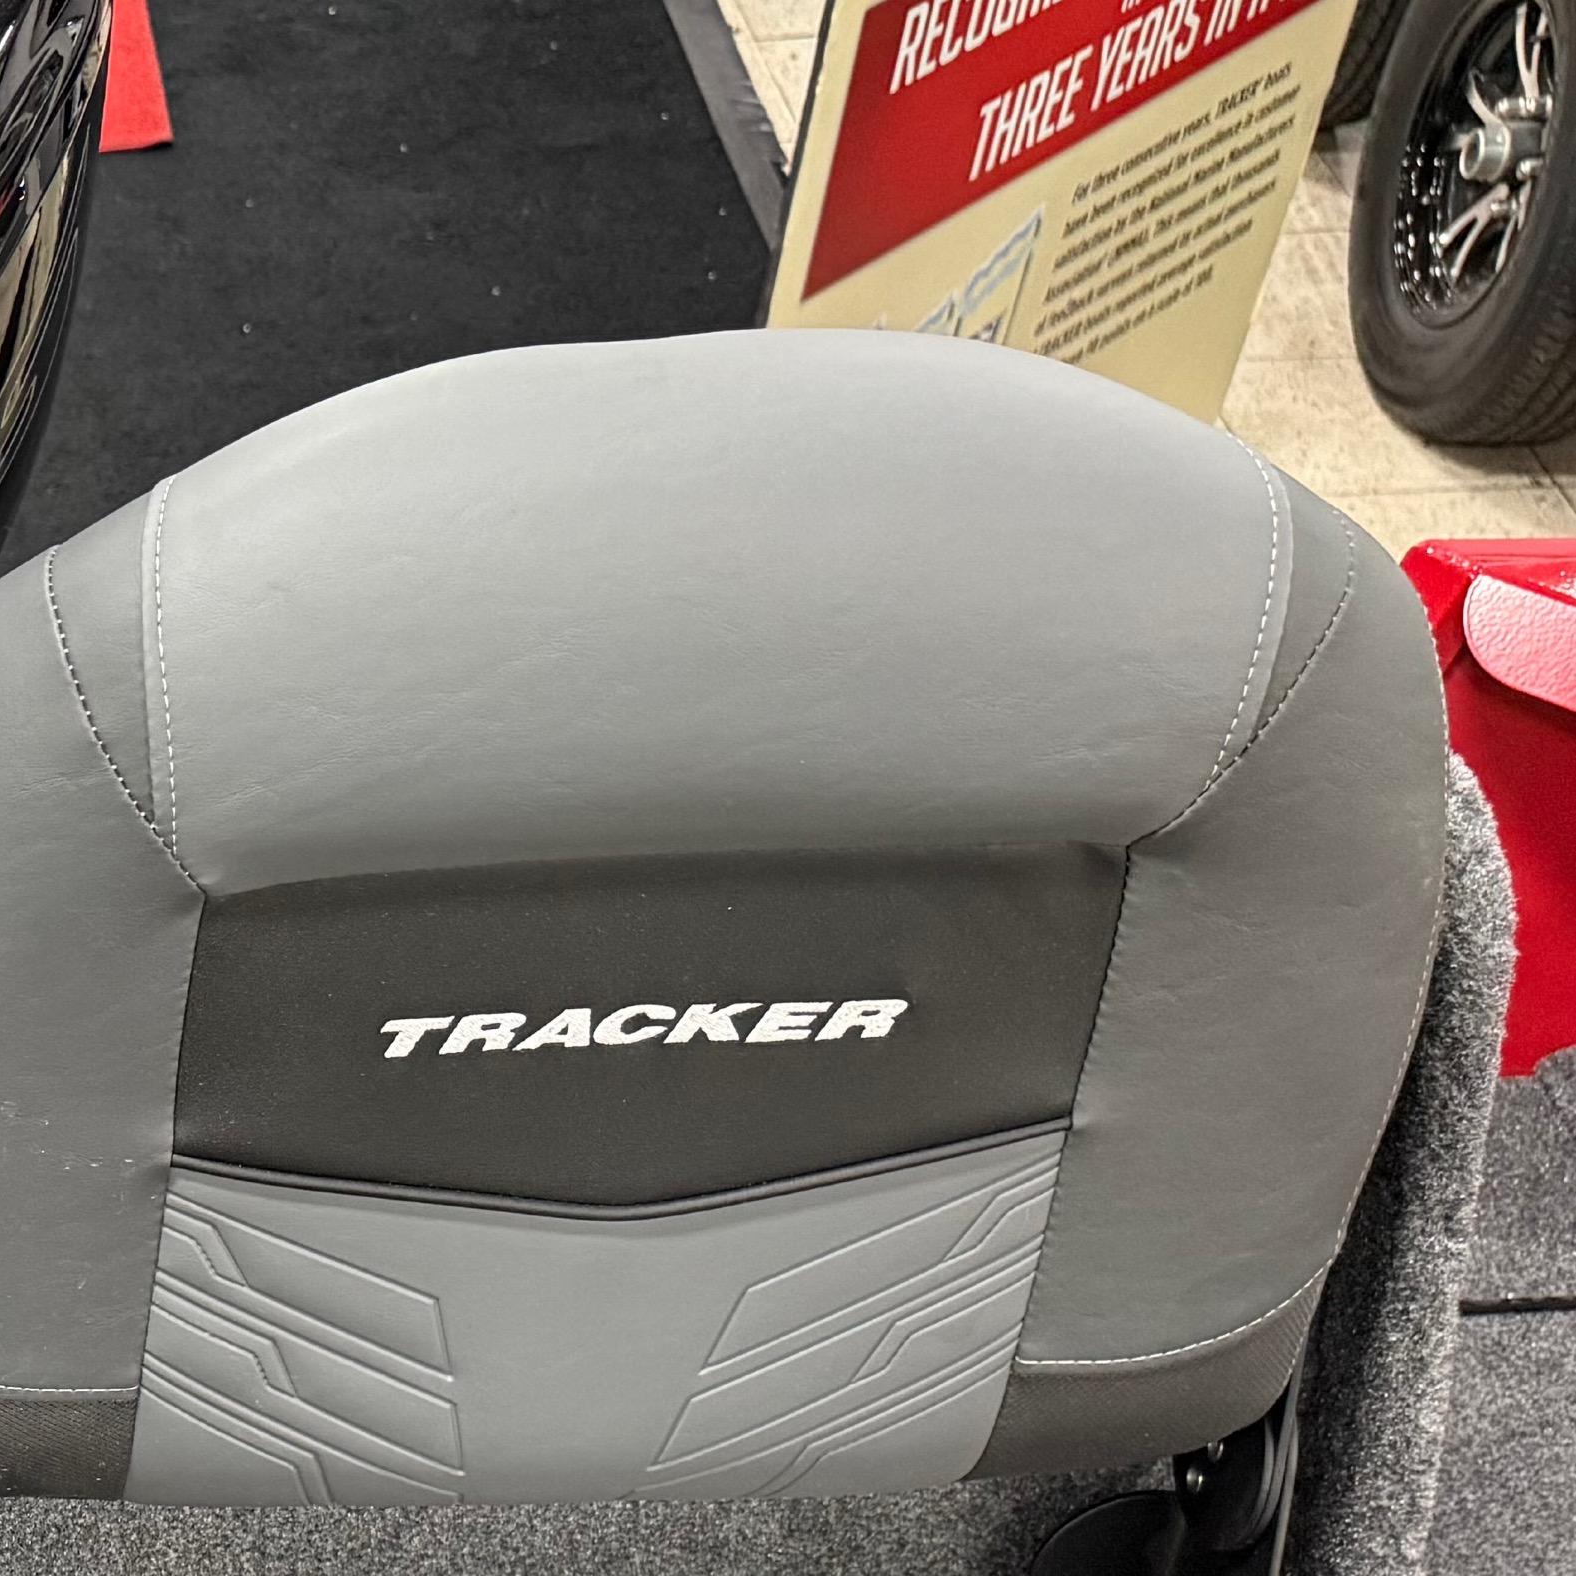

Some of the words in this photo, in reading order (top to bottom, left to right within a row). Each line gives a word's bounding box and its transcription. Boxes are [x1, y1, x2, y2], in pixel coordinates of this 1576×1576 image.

[969, 44, 1093, 182] THREE
[1090, 0, 1201, 111] YEARS
[1091, 165, 1119, 192] three
[380, 998, 909, 1058] TRACKER
